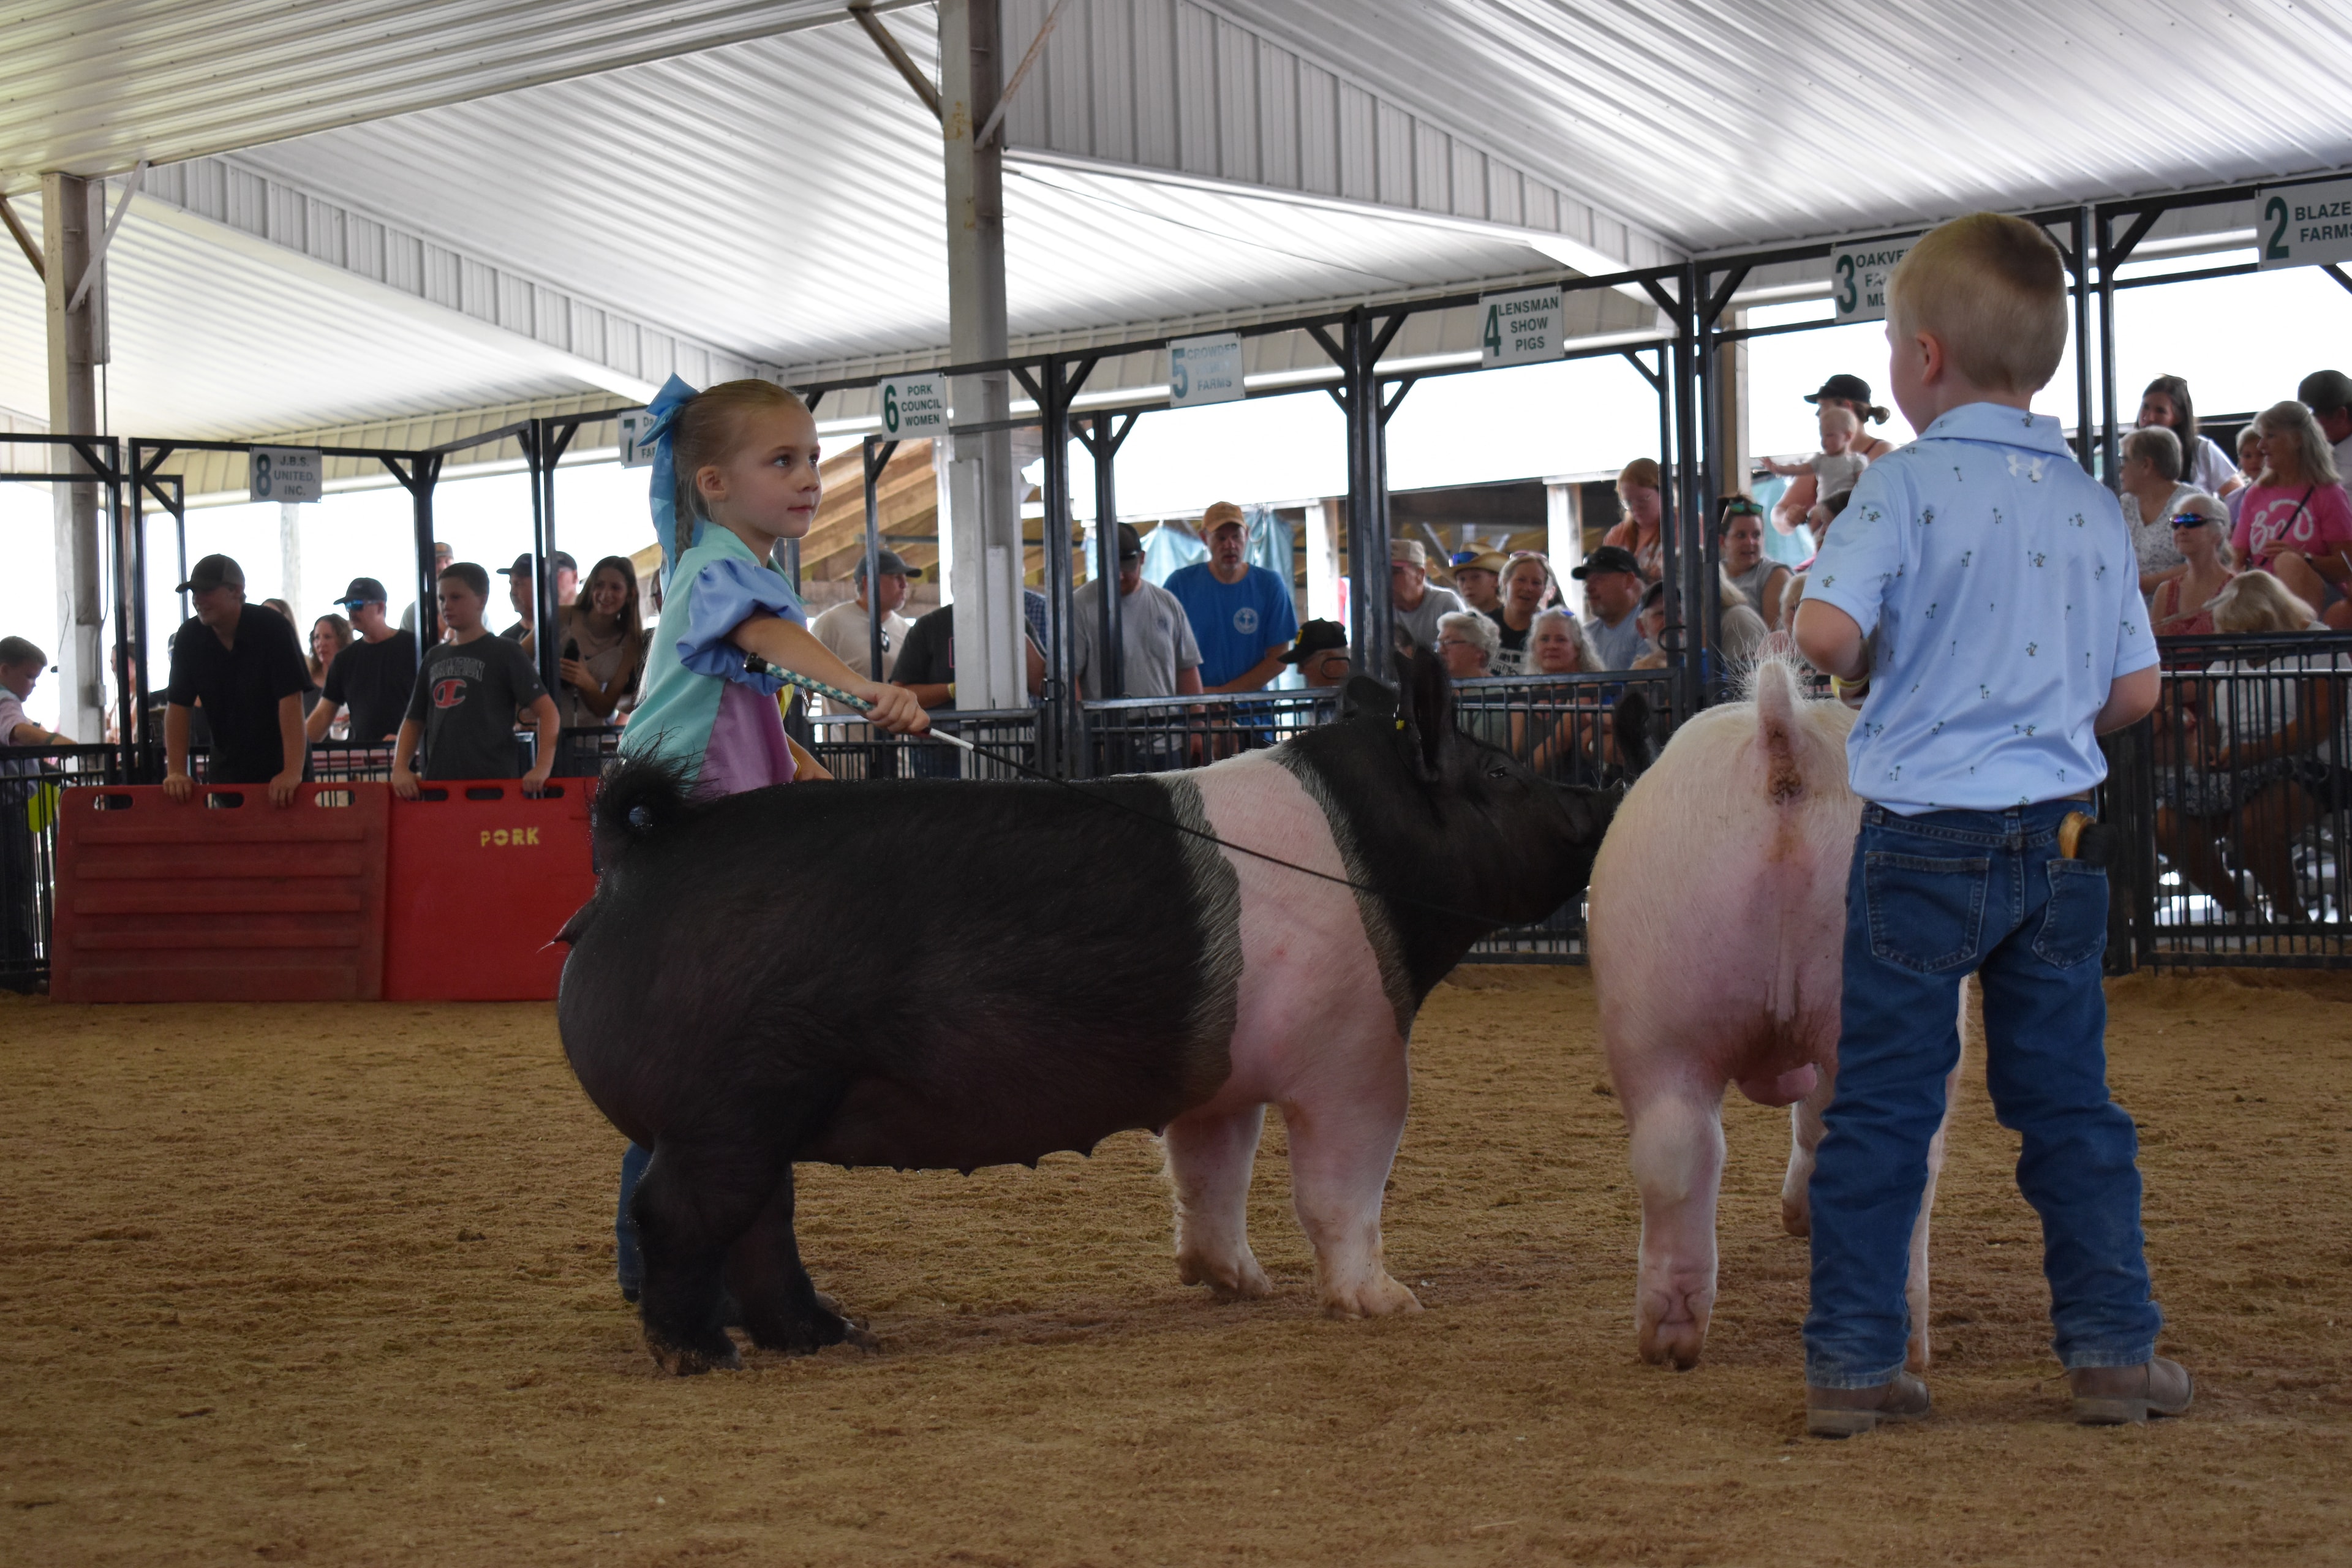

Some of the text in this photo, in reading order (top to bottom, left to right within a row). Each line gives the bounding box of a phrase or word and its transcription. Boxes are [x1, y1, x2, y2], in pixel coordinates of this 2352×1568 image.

[2294, 201, 2352, 221] BLAZE
[2264, 195, 2290, 260] 2
[2300, 223, 2352, 243] FARM
[1855, 249, 1909, 268] OAKVE
[1835, 254, 1857, 314] 3
[1498, 296, 1559, 316] LENSMAN
[1483, 304, 1502, 357] 4
[1510, 316, 1548, 334] SHOW
[1515, 336, 1545, 352] PIGS
[1172, 347, 1188, 399] 5
[907, 384, 933, 396] PORK
[1197, 377, 1232, 391] FARMS
[884, 384, 899, 434] 6
[900, 398, 942, 412] COUNCIL
[905, 413, 940, 426] WOMEN
[623, 418, 636, 462] 7
[280, 455, 309, 467] J.B.S.
[256, 453, 272, 497] 8
[273, 470, 316, 483] UNITED,
[284, 484, 306, 496] INC.
[480, 826, 540, 848] PORK
